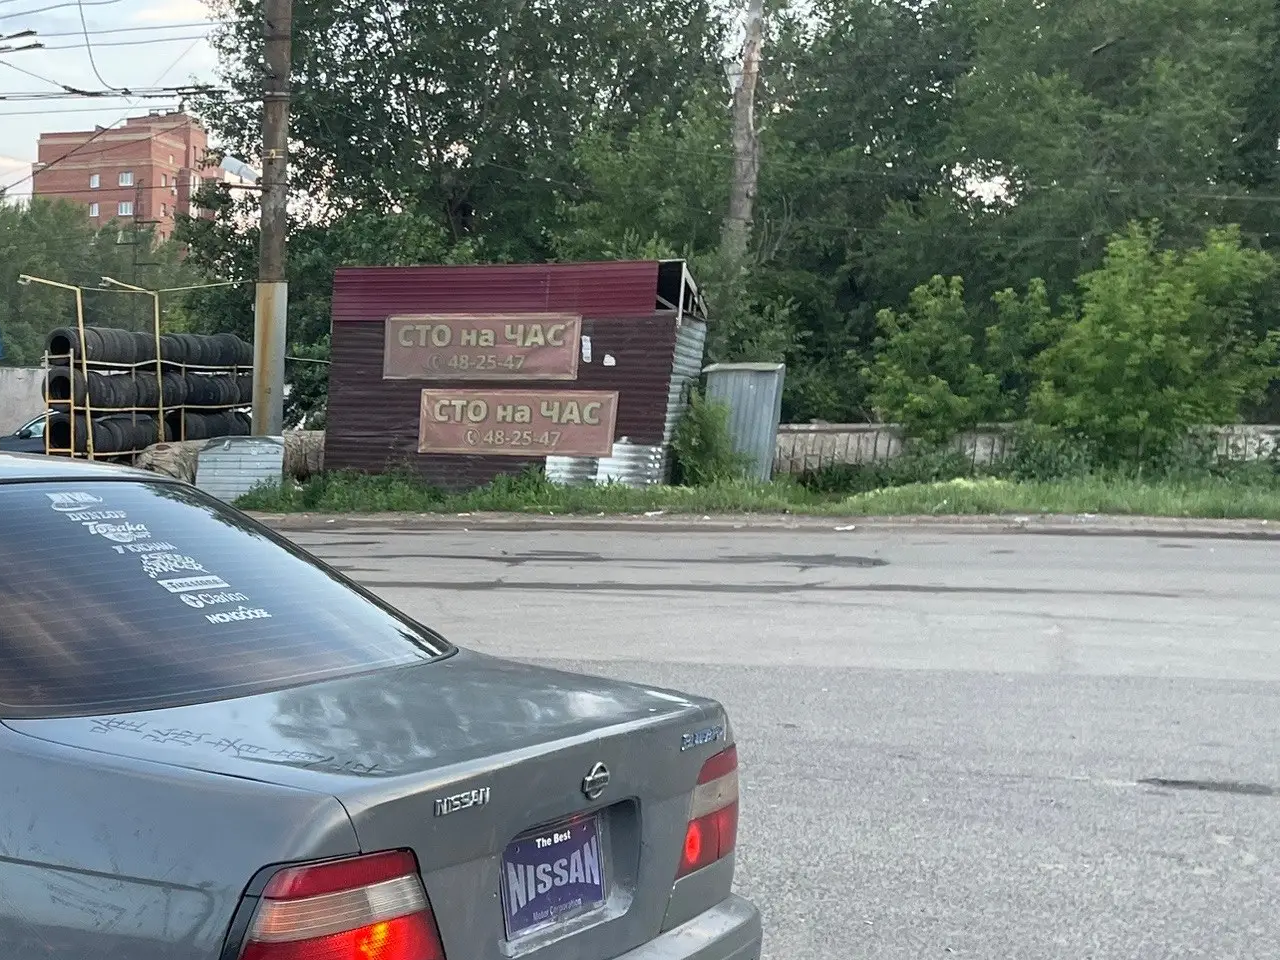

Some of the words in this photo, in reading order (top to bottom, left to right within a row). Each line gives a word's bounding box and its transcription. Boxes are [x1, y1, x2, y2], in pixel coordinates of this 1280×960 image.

[397, 324, 453, 348] СТО
[460, 327, 495, 347] на
[504, 323, 568, 347] ЧАС
[448, 353, 526, 371] 48-25-47
[433, 399, 489, 424] СТО
[496, 403, 531, 424] на
[541, 400, 602, 425] ЧАС
[483, 430, 562, 446] 48-25-47
[434, 787, 490, 816] NISSAN
[536, 838, 553, 849] The
[553, 829, 572, 844] Best
[506, 834, 601, 917] NISSAN
